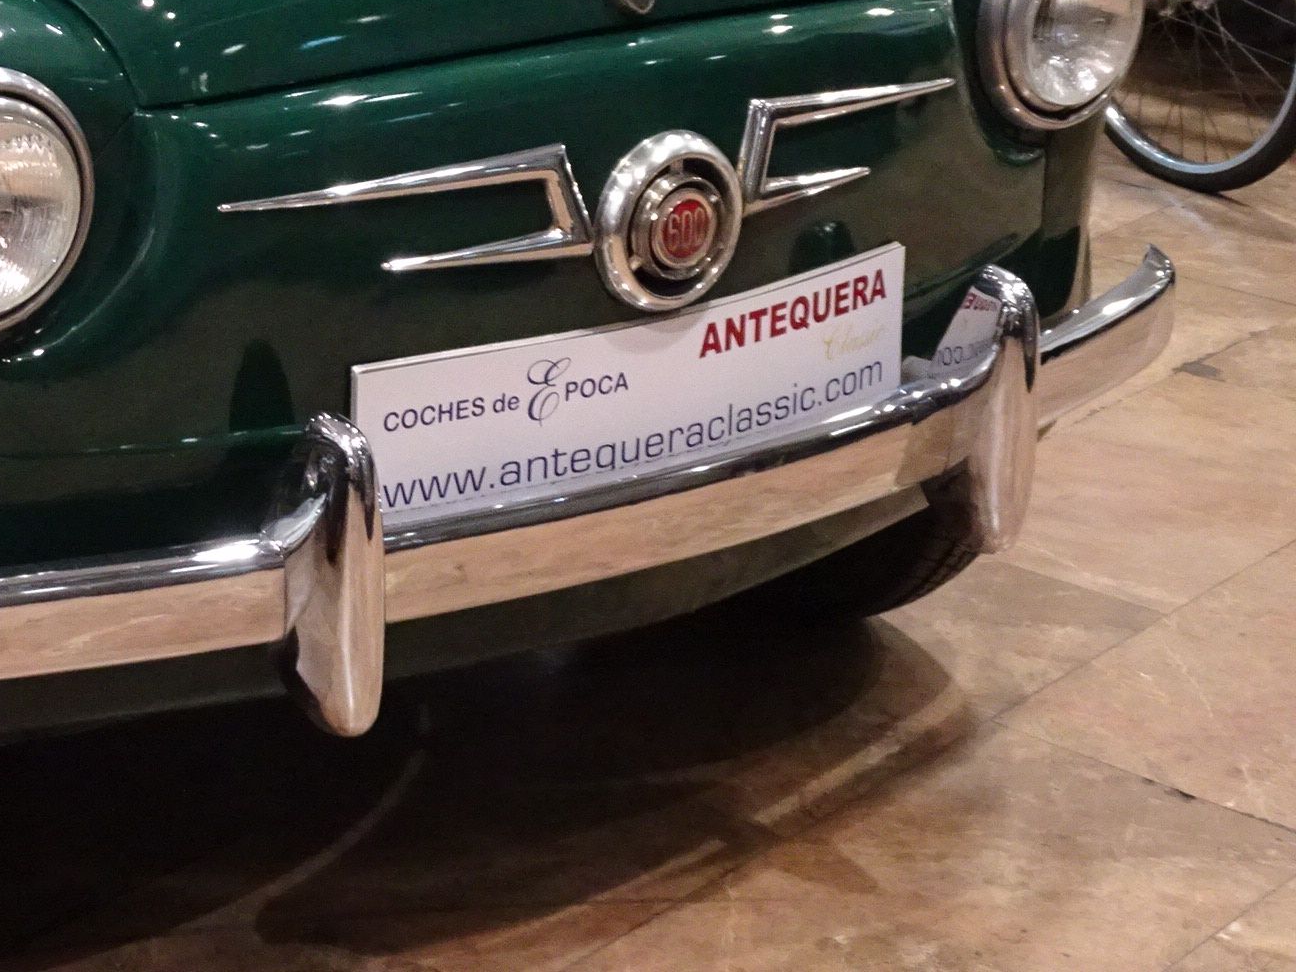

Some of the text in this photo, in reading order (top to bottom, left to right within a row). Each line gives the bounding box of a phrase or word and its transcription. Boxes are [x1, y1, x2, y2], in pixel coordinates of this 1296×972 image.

[667, 206, 706, 247] 600
[699, 269, 887, 359] ANTEQUERA
[383, 397, 486, 432] COCHES
[492, 393, 520, 414] de
[383, 360, 883, 508] www.antequeraclassic.com
